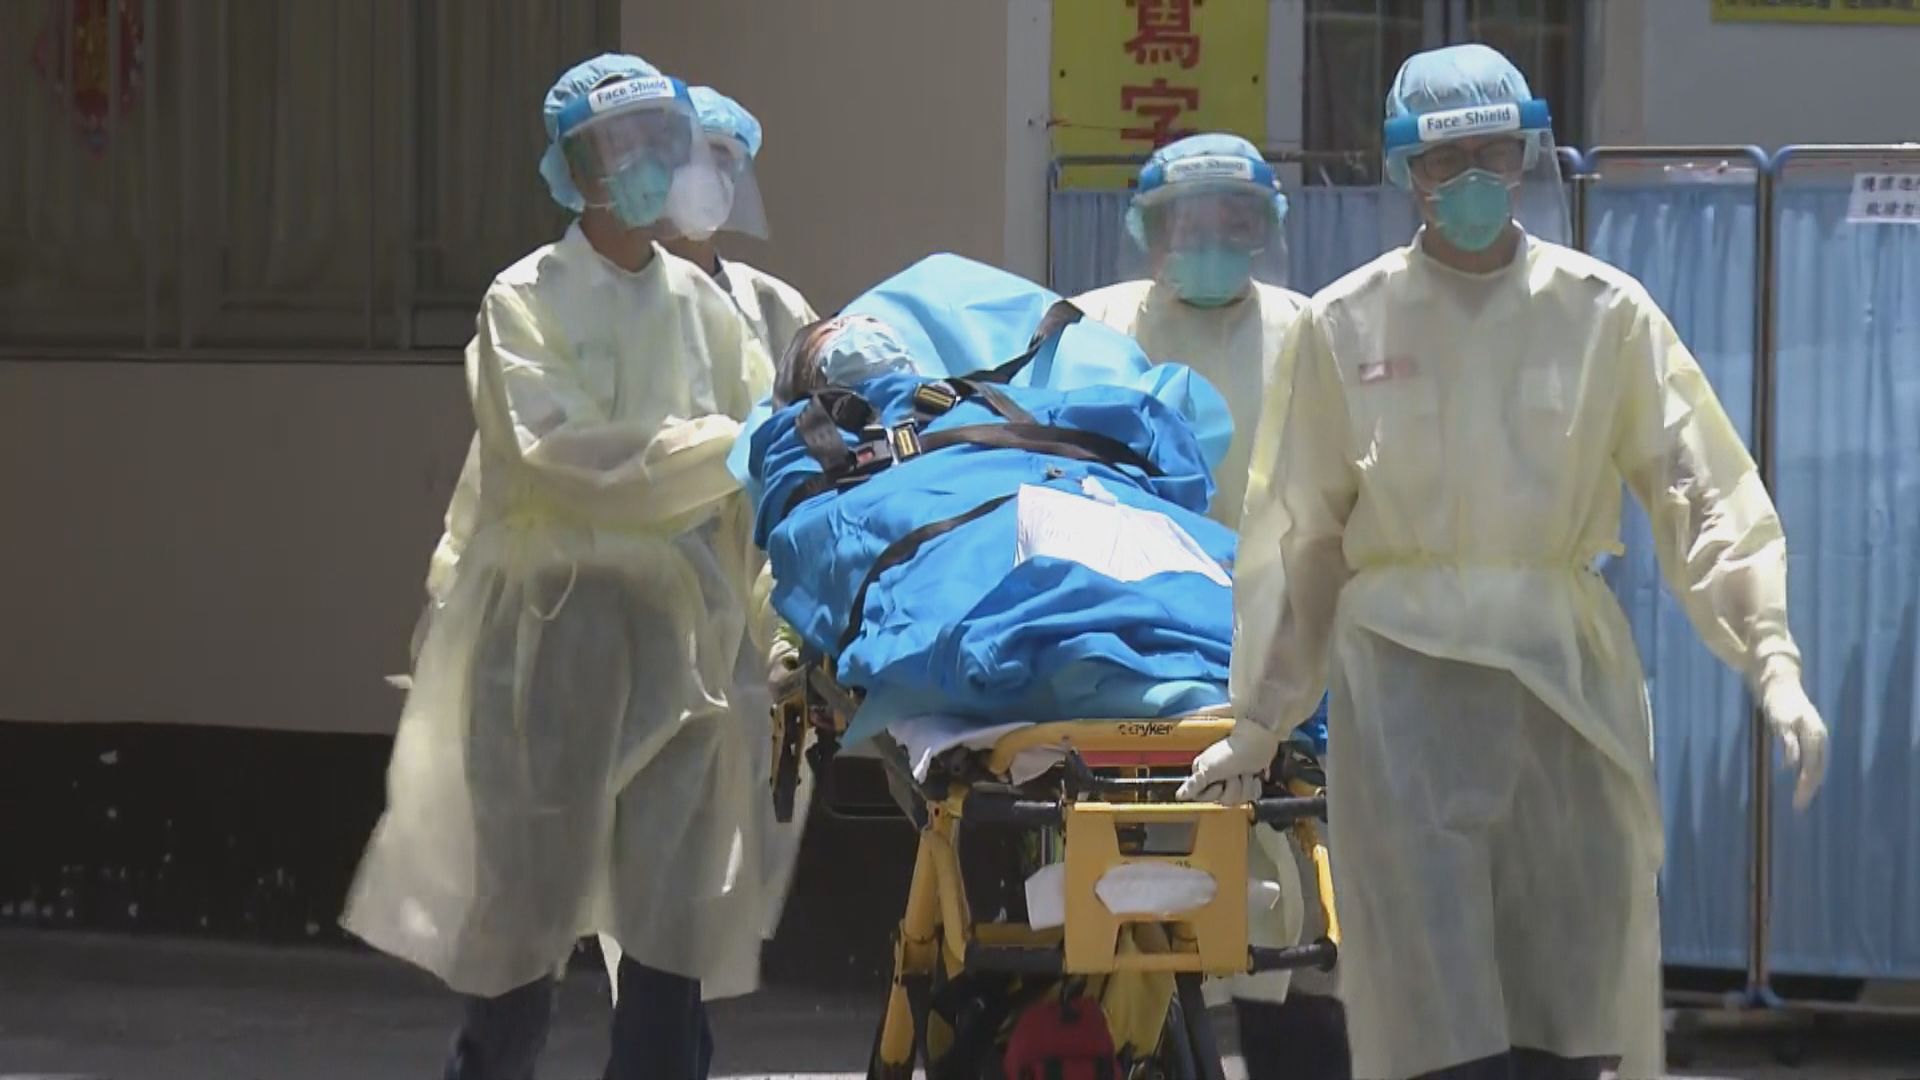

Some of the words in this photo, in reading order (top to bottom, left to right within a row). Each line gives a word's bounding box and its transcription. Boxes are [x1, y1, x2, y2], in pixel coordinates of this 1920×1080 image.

[596, 87, 626, 104] Face
[629, 79, 667, 95] Shield
[1119, 0, 1200, 188] 寫字
[1426, 114, 1457, 130] Face
[1465, 107, 1511, 125] Shield
